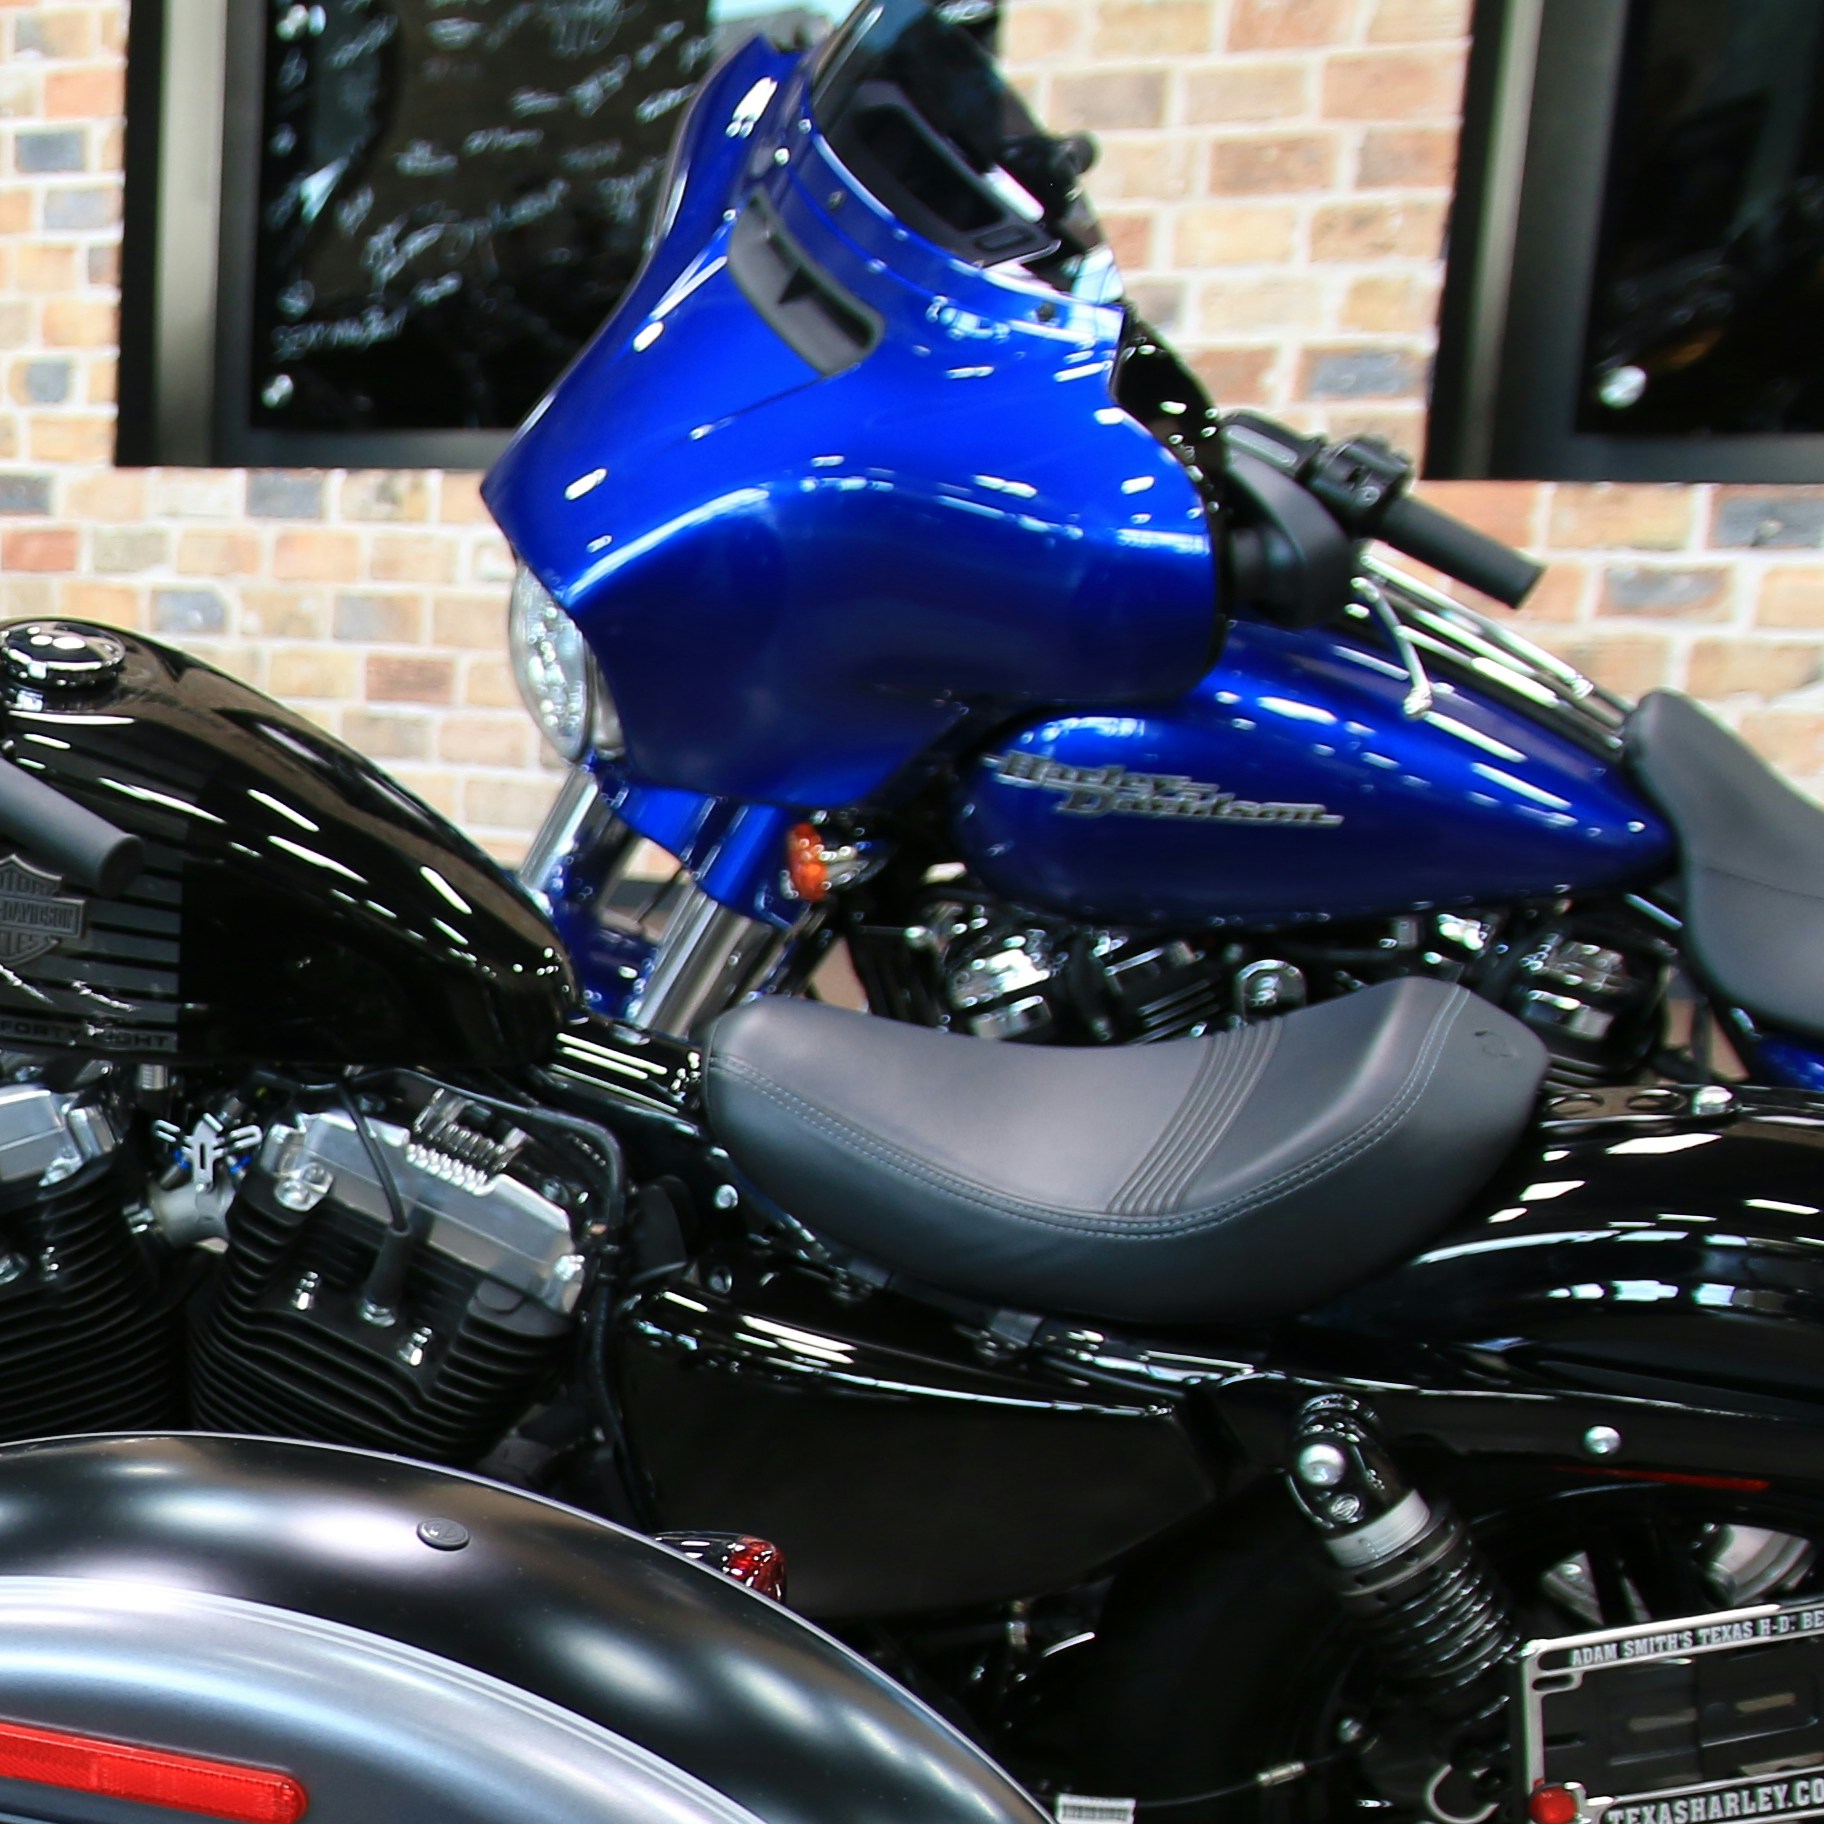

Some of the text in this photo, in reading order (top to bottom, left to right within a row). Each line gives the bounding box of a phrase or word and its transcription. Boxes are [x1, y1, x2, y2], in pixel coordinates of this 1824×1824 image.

[1571, 1643, 1619, 1667] ADAM
[1623, 1631, 1694, 1658] SMITH'S
[1698, 1621, 1753, 1647] TEXAS
